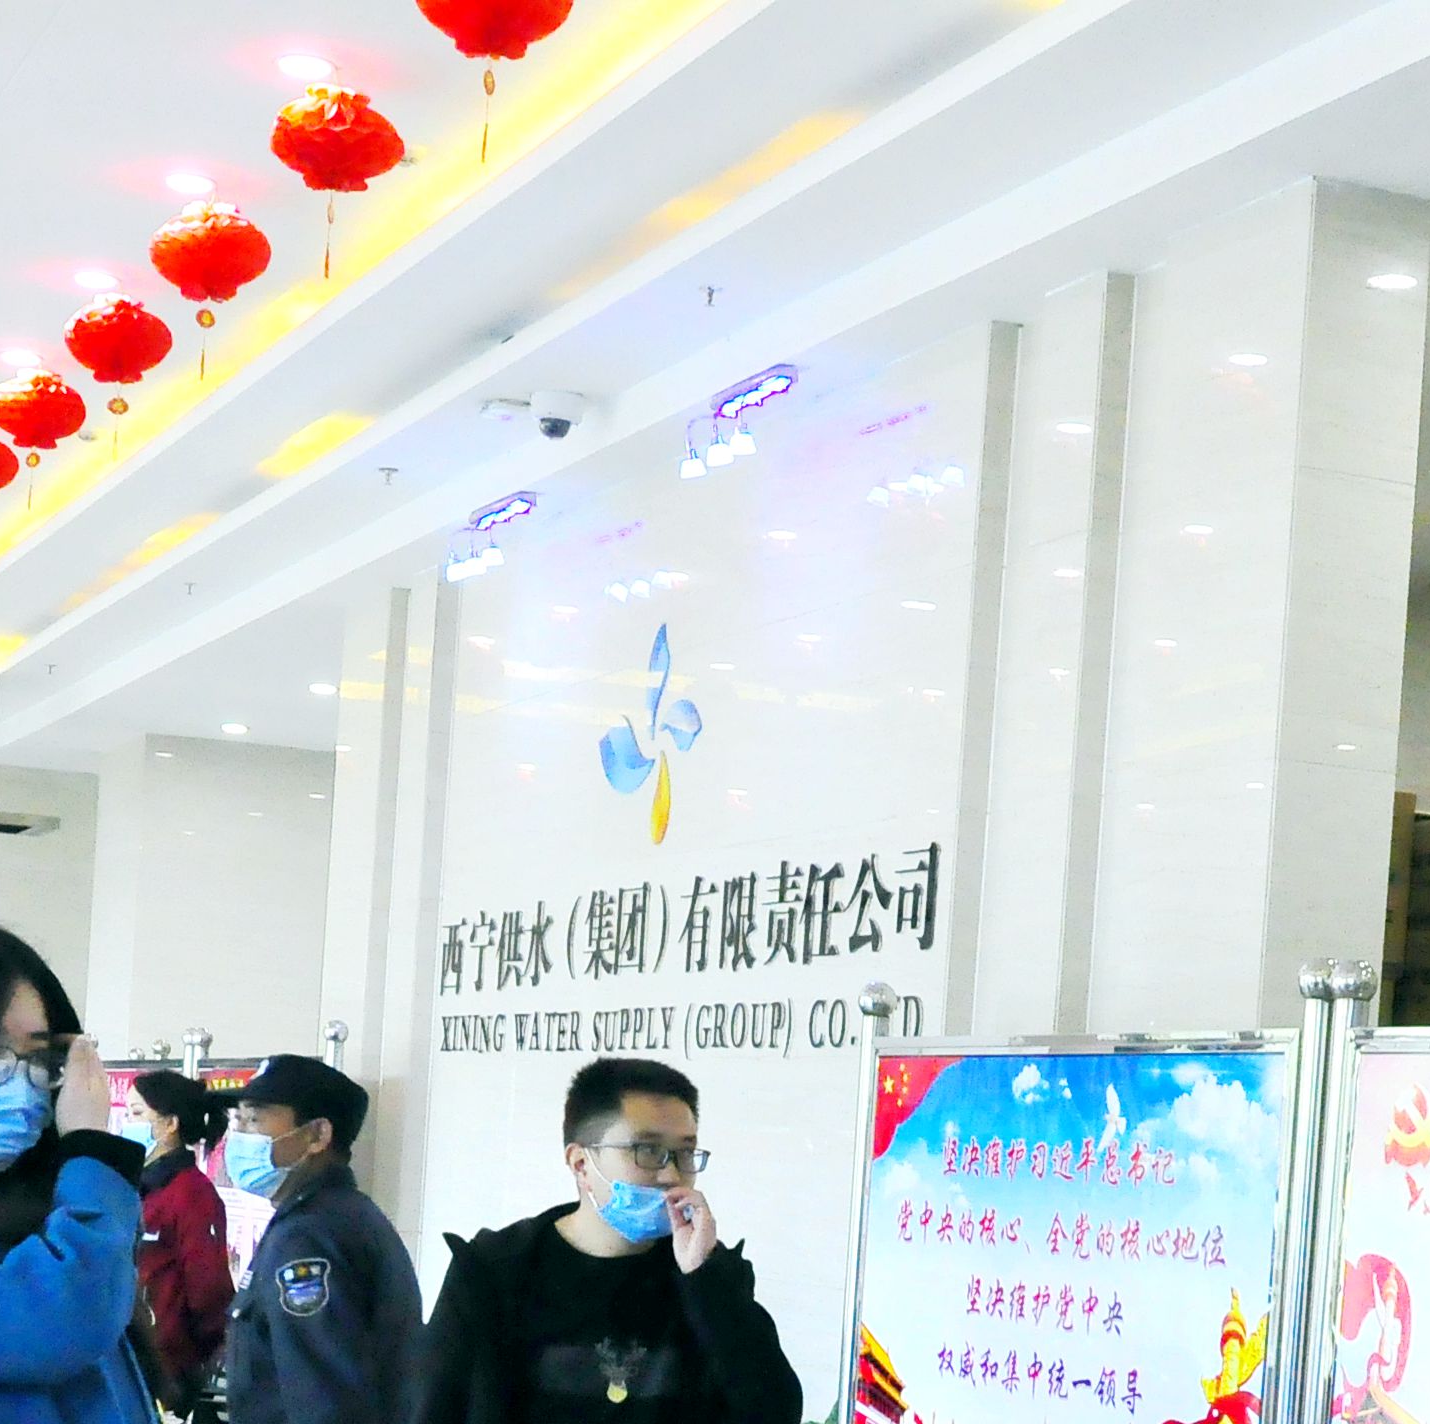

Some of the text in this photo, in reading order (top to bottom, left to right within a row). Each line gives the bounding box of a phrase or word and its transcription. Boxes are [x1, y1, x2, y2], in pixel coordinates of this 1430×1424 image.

[439, 841, 942, 997] 西宁供水（集团）有限责任公司
[439, 1013, 506, 1053] XINING
[515, 1010, 582, 1053] WATER
[590, 1005, 676, 1053] SUPPLY
[683, 997, 793, 1060] (GROUP)
[808, 998, 858, 1049] CO.
[941, 1136, 1178, 1188] 坚决维护习近平总书记
[896, 1200, 1229, 1268] 党中央的核心、全党的核心地位
[965, 1275, 1125, 1337] 坚决维护党中央
[937, 1341, 1144, 1416] 权威和集中统一领导
